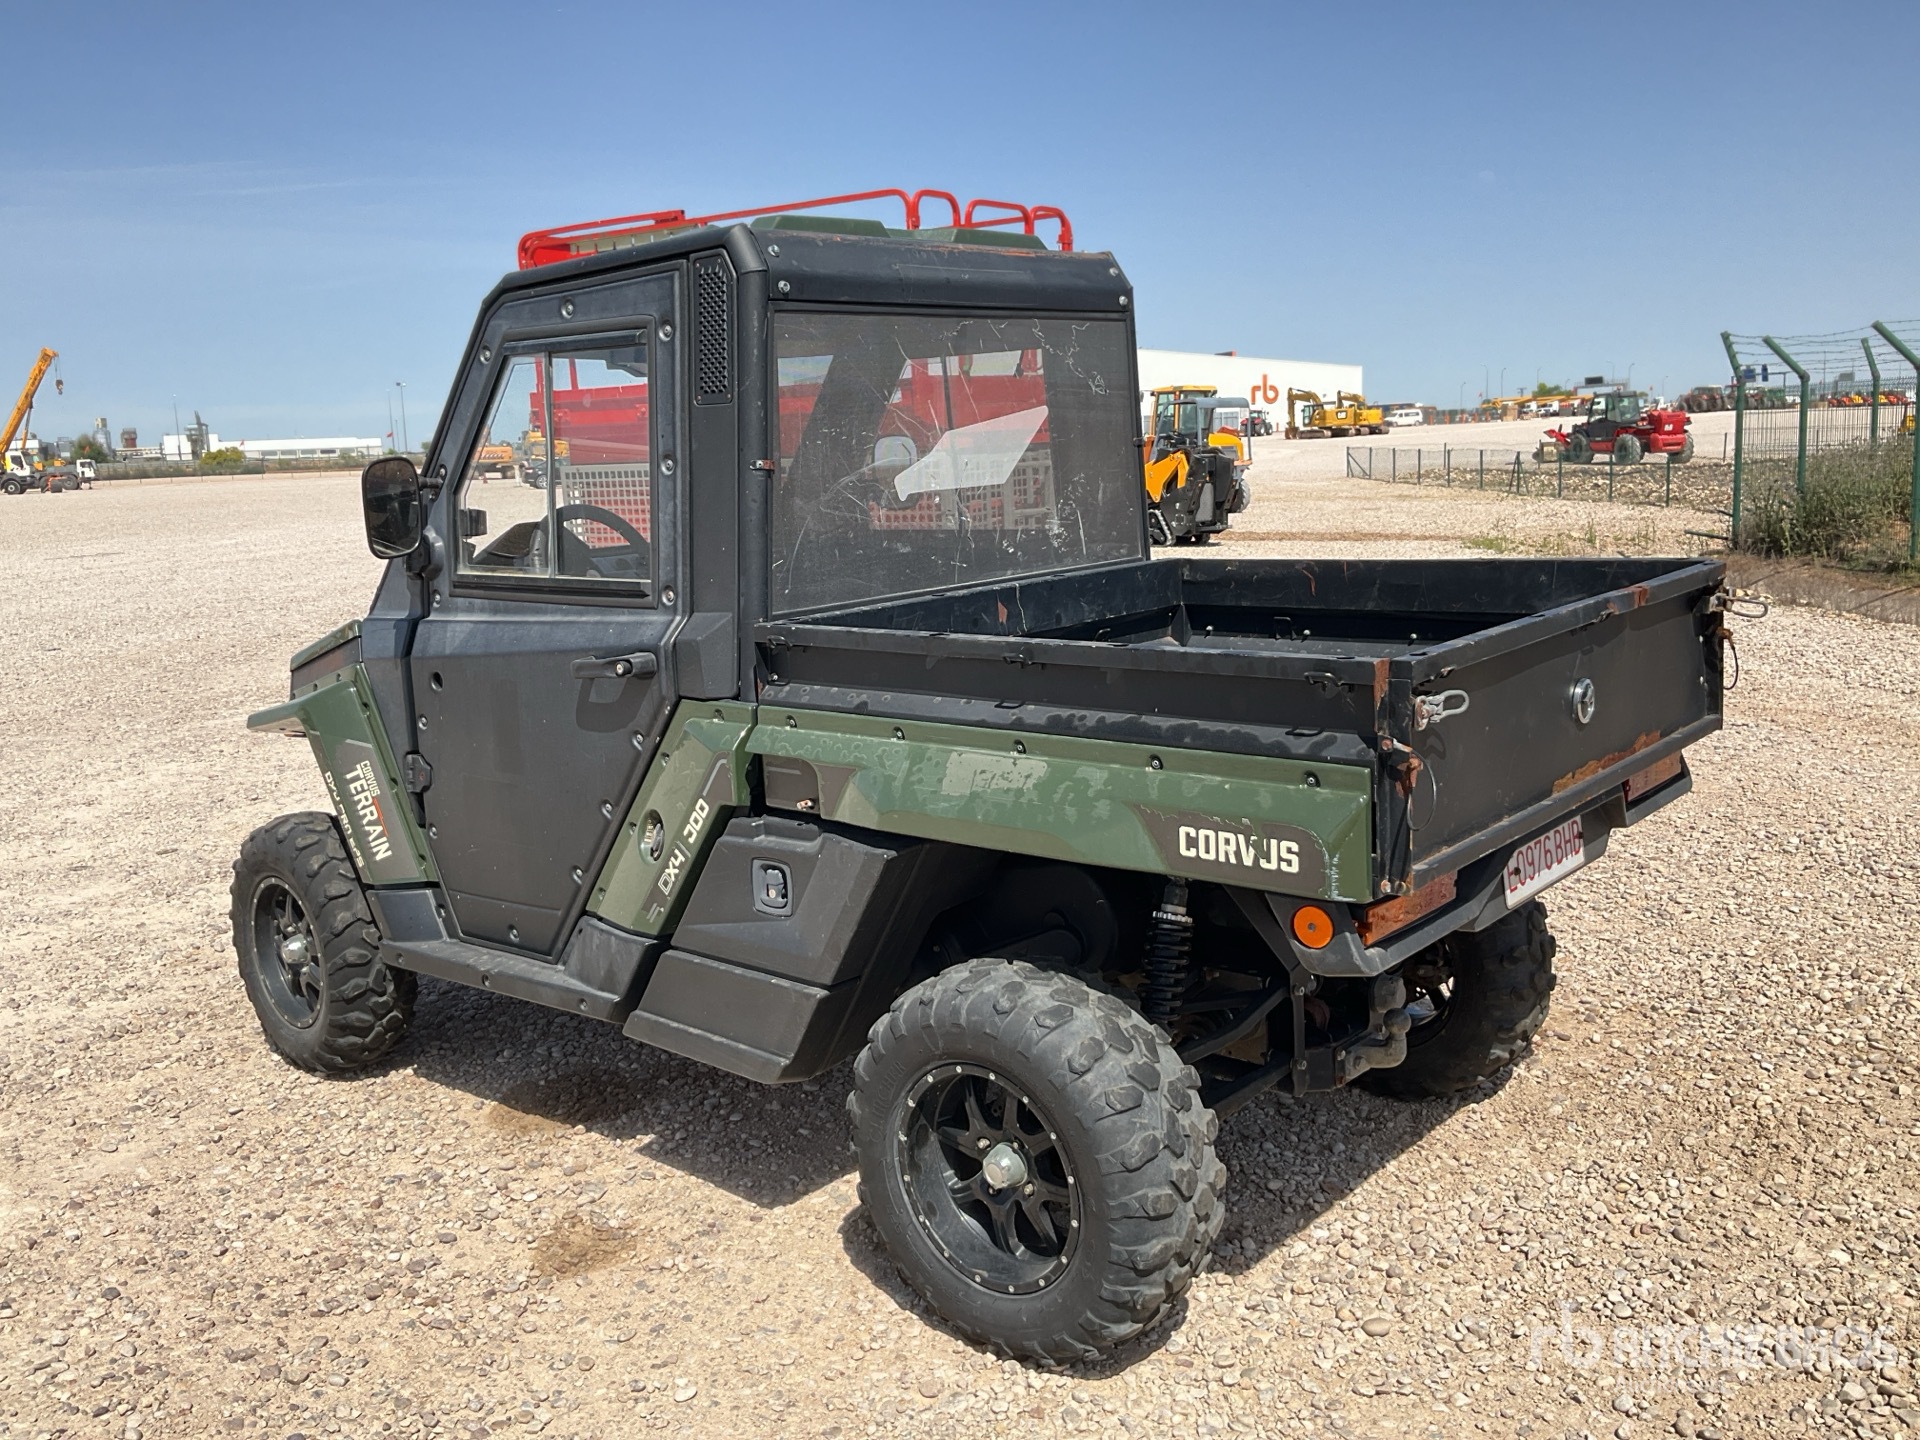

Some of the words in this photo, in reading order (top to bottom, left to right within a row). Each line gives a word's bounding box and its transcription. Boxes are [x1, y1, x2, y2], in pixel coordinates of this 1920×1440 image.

[1251, 374, 1279, 405] rb
[361, 760, 380, 797] CORVUS
[345, 763, 392, 861] TERRAIN
[658, 849, 686, 896] DX4
[1179, 826, 1299, 873] CORVUS
